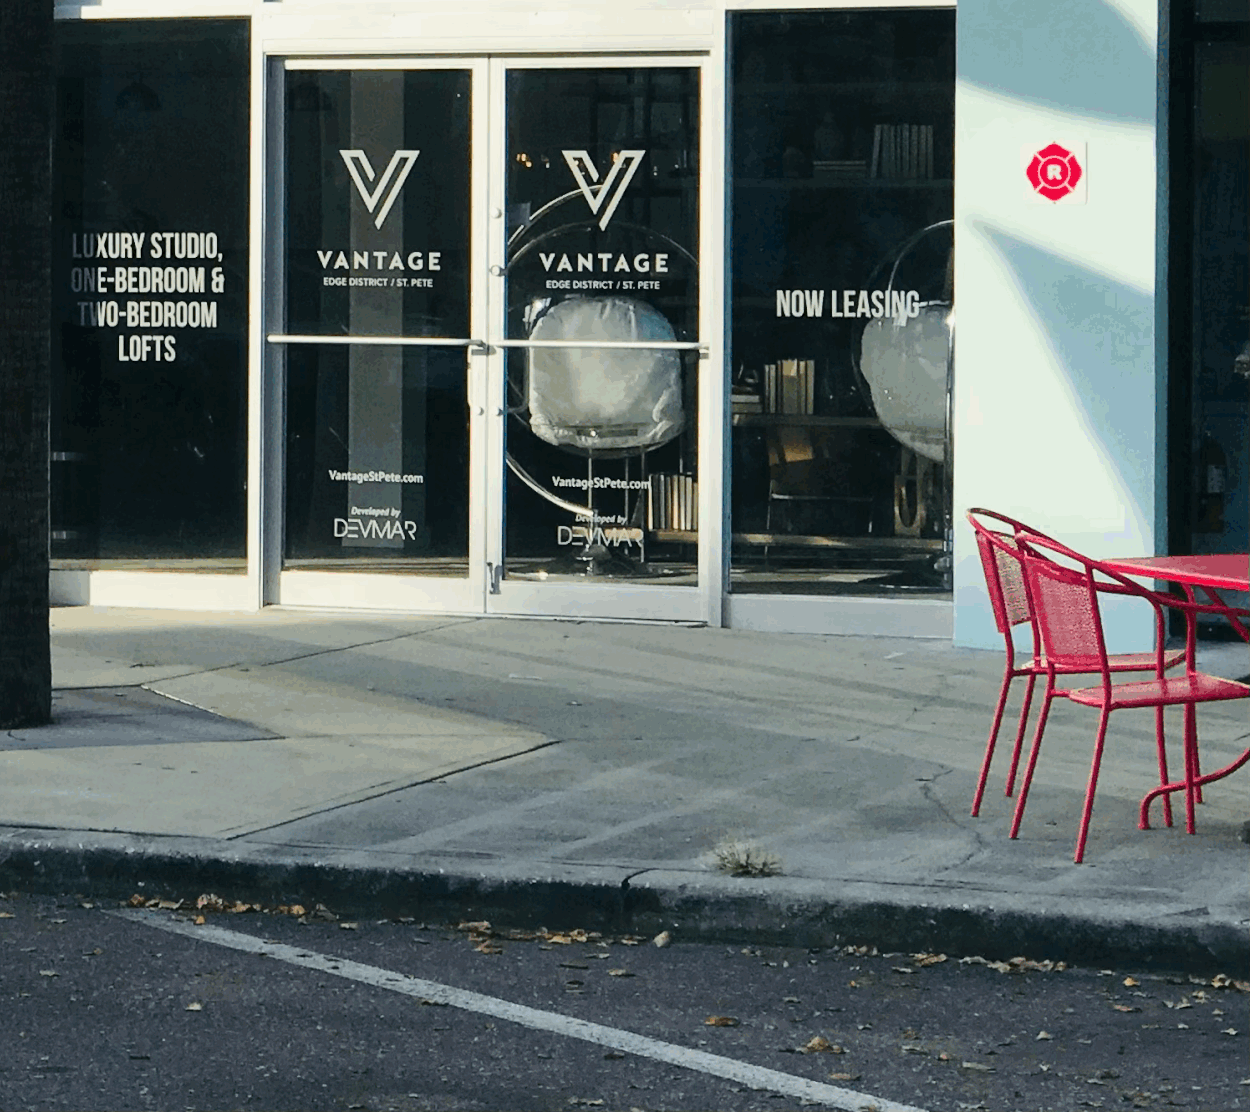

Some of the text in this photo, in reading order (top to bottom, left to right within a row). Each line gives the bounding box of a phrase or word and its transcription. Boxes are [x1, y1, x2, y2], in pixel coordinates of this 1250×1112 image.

[1047, 164, 1062, 180] R
[72, 232, 223, 262] LUXURY STUDIO,
[316, 250, 442, 271] VANTAGE
[539, 253, 669, 273] VANTAGE
[71, 267, 225, 293] ONE-BEDROOM &
[323, 277, 347, 287] EDGE
[349, 277, 389, 287] DISTRICT
[396, 278, 410, 288] ST.
[411, 278, 434, 288] PETE
[546, 279, 571, 289] EDGE
[573, 280, 614, 290] DISTRICT
[622, 280, 636, 290] ST.
[638, 280, 661, 290] PETE
[776, 289, 920, 318] NOW LEASING
[77, 301, 217, 328] TWO-BEDROOM
[118, 335, 176, 362] LOFTS
[328, 469, 424, 484] VantageStPete.com
[552, 476, 650, 490] VantageStPete.com
[351, 506, 401, 518] Developed by
